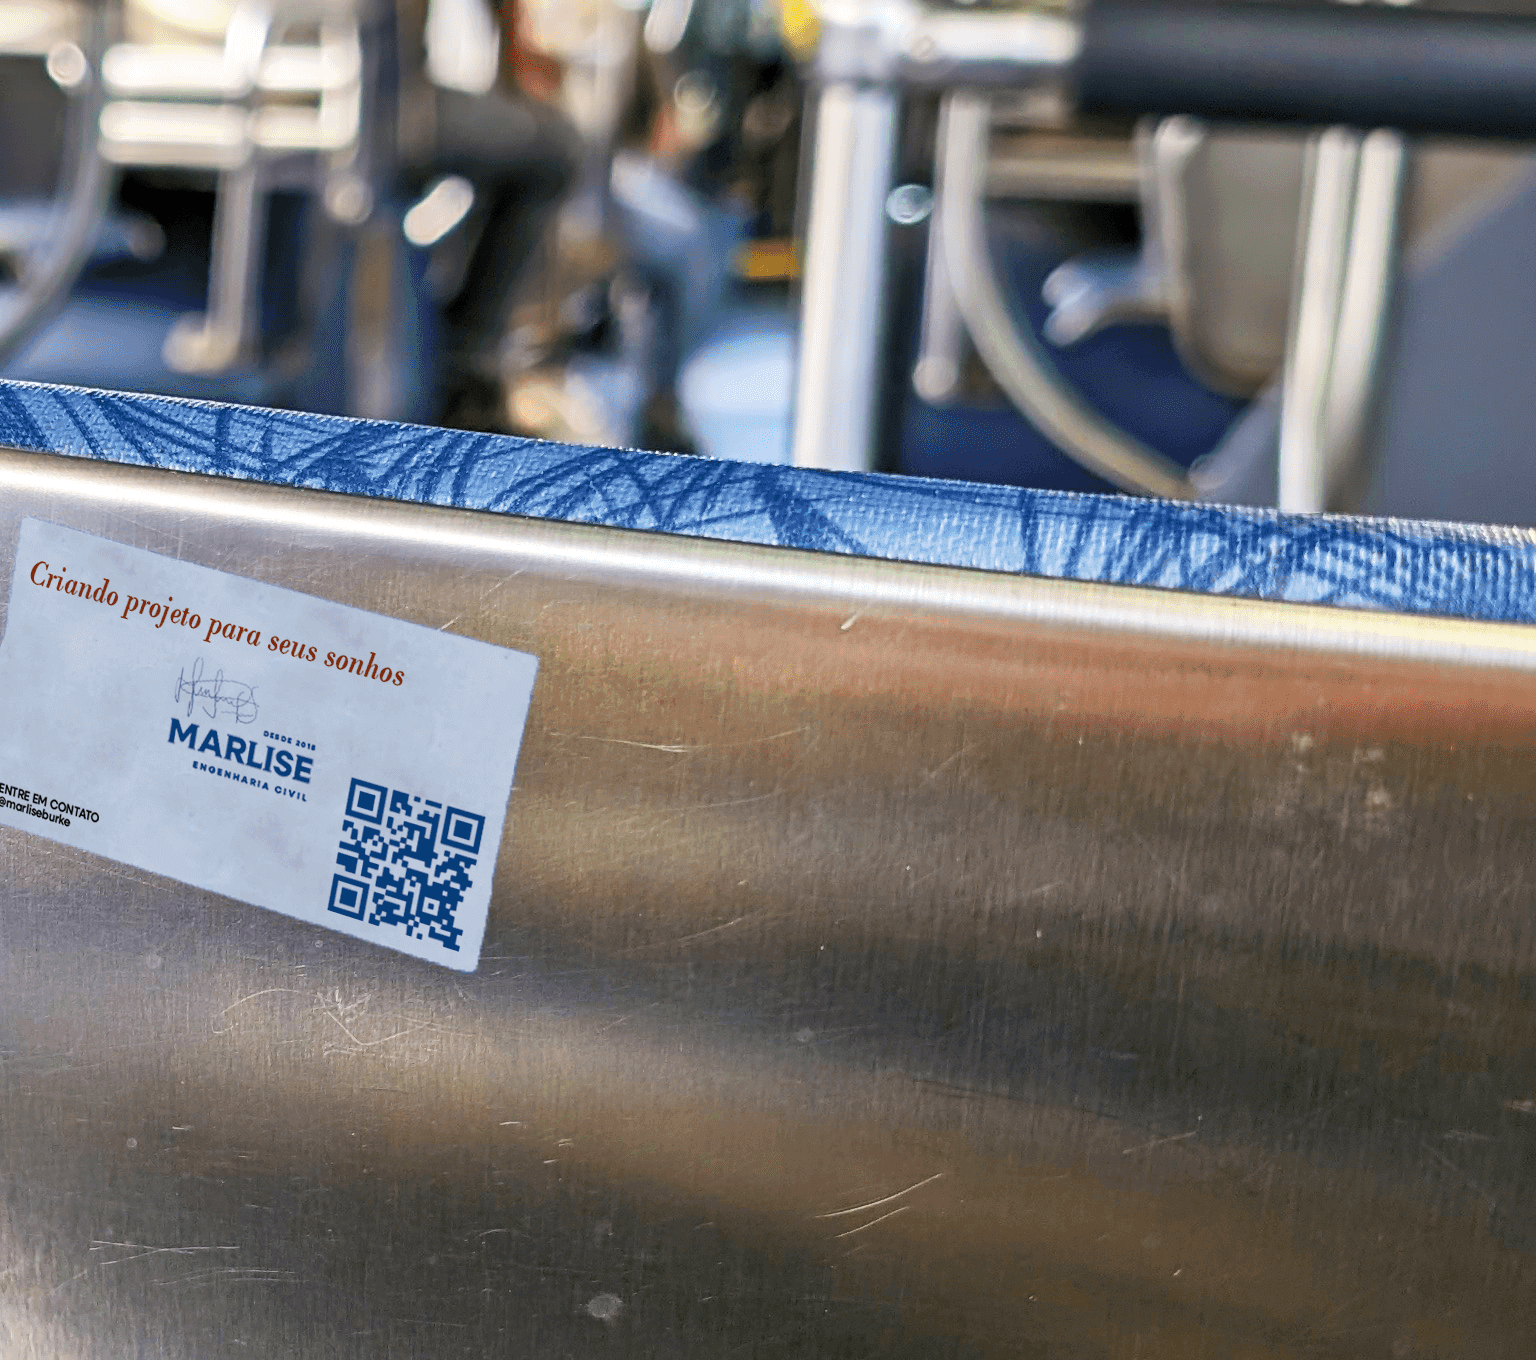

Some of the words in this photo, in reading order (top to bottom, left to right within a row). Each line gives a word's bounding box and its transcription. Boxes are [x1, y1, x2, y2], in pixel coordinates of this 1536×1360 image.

[30, 560, 119, 606] Criando
[120, 594, 202, 629] projeto
[203, 617, 262, 647] para
[267, 635, 318, 662] seus
[324, 651, 405, 686] sonhos
[167, 717, 314, 785] MARLISE
[263, 730, 293, 745] DESDE
[192, 760, 270, 791] ENGENHARIA
[274, 785, 308, 803] CIVIL
[32, 793, 48, 807] EM
[49, 798, 100, 823] CONTATO
